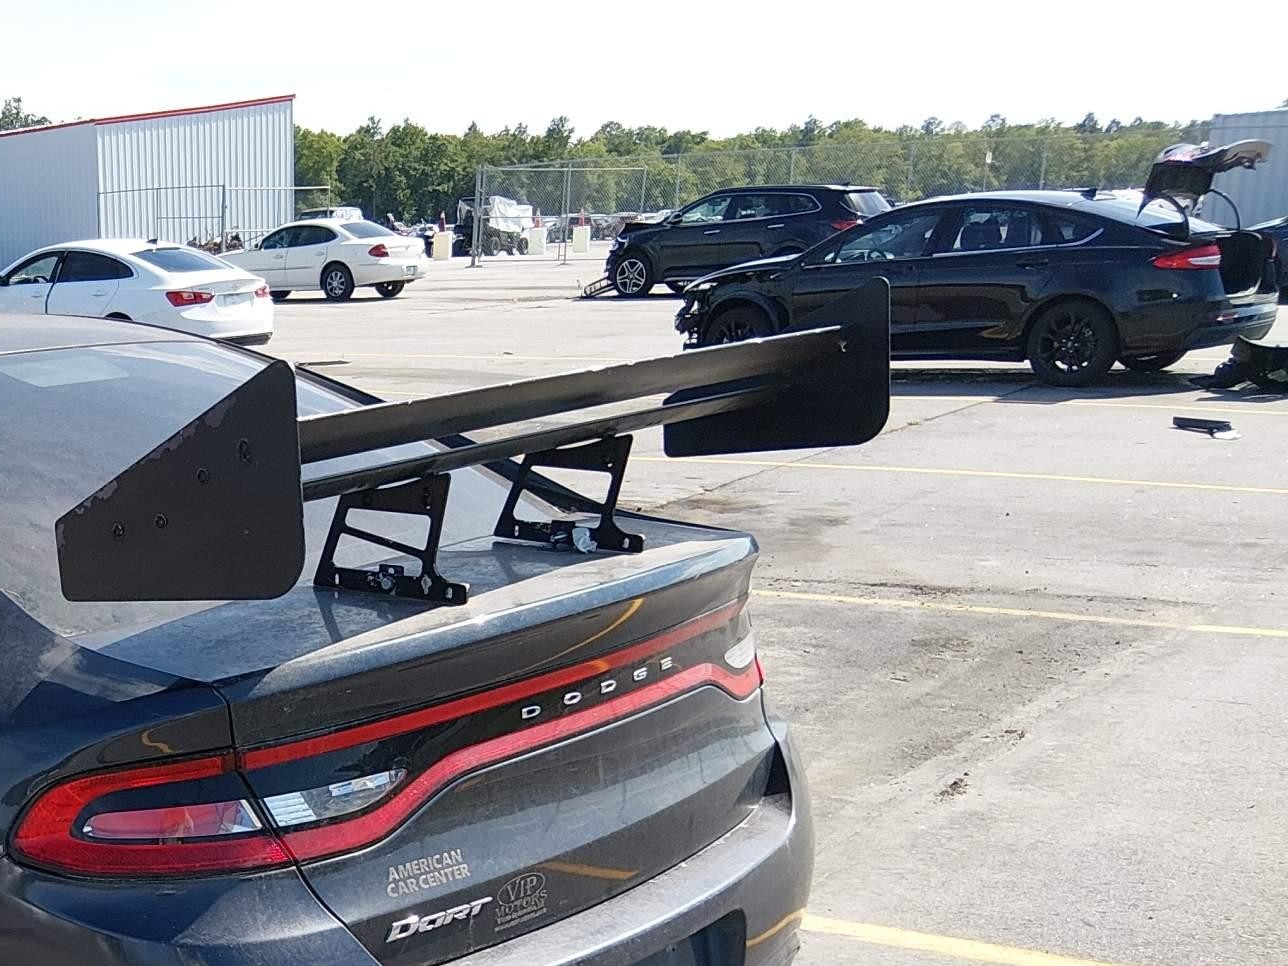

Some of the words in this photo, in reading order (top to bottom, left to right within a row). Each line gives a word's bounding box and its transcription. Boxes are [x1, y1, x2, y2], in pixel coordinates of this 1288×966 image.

[521, 656, 673, 719] DODGE
[386, 880, 419, 898] CAR
[419, 863, 471, 889] CENTER
[388, 848, 463, 882] AMERICAN
[495, 890, 548, 916] MOTORS
[506, 875, 538, 901] VIP
